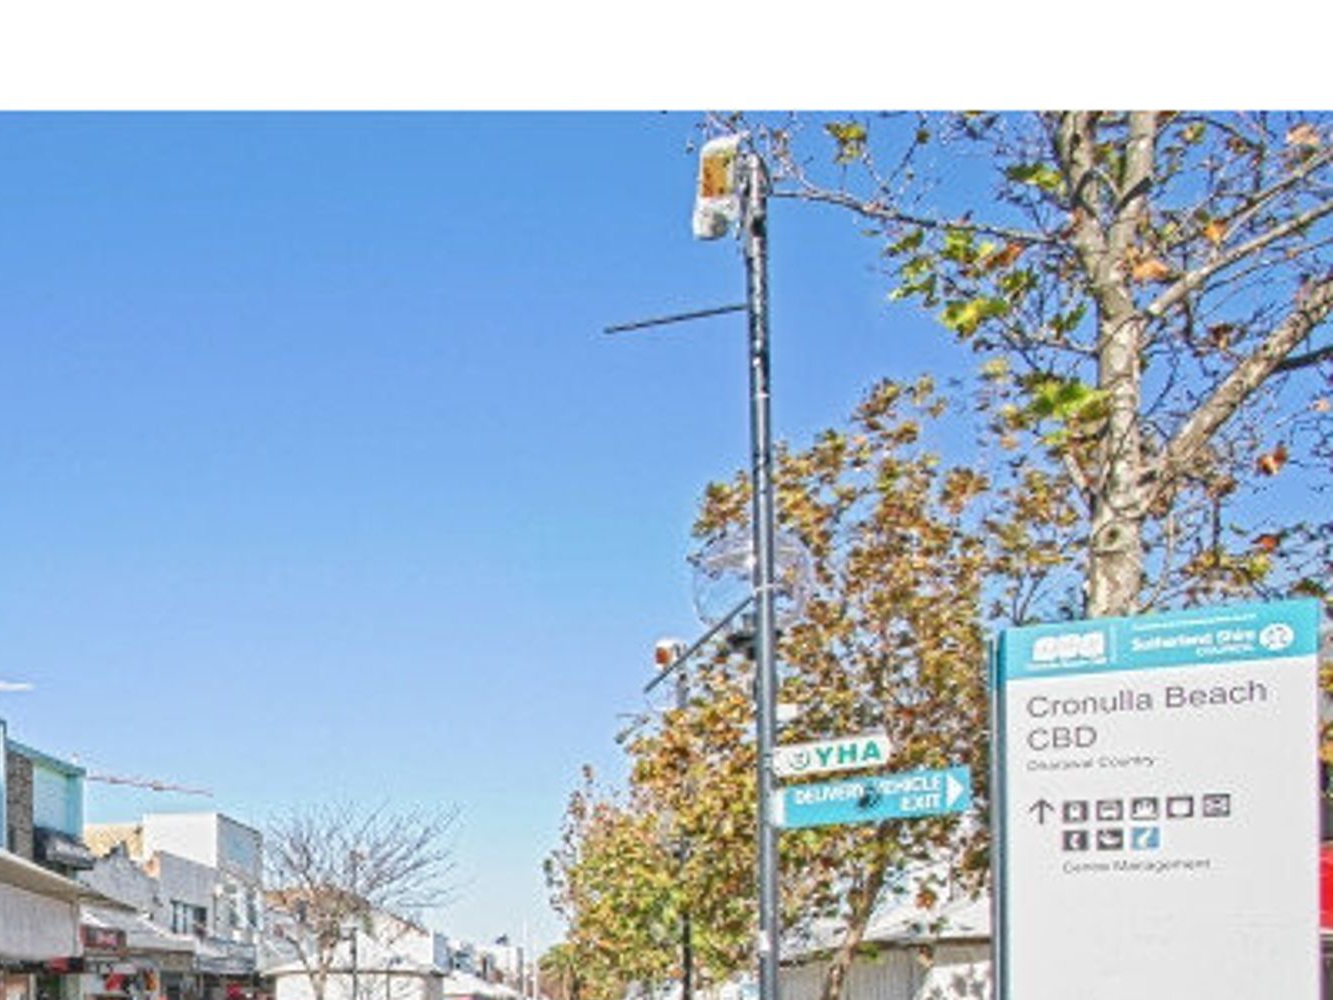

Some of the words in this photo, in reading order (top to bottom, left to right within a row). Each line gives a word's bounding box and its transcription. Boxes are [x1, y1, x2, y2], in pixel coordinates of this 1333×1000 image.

[1026, 689, 1153, 718] Cronulla
[1165, 680, 1267, 708] Beach
[1026, 726, 1098, 751] CBD
[816, 741, 882, 766] YHA
[900, 793, 941, 811] EXIT
[1113, 857, 1211, 874] Management
